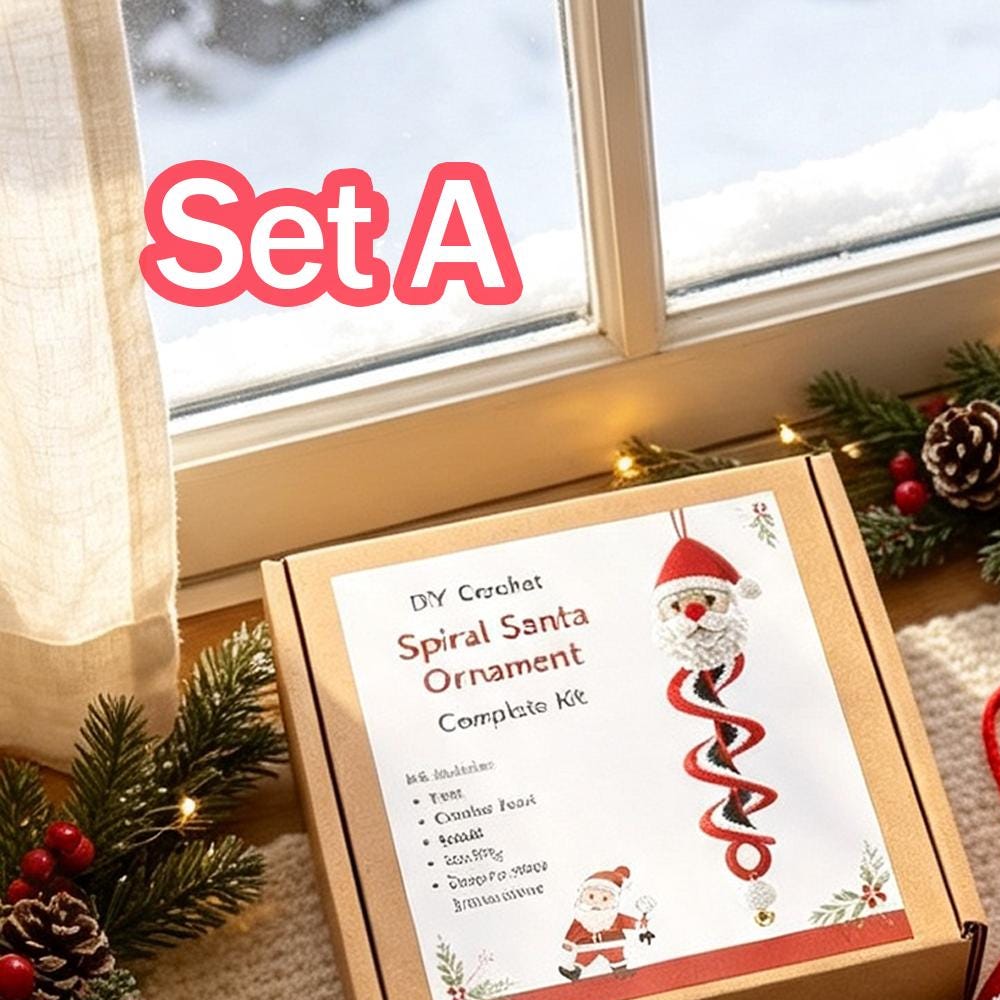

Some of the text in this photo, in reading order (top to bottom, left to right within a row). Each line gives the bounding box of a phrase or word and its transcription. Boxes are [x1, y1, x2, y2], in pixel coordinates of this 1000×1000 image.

[410, 588, 447, 612] DIY
[397, 606, 589, 663] Spiral Santa
[423, 643, 585, 694] Ornament
